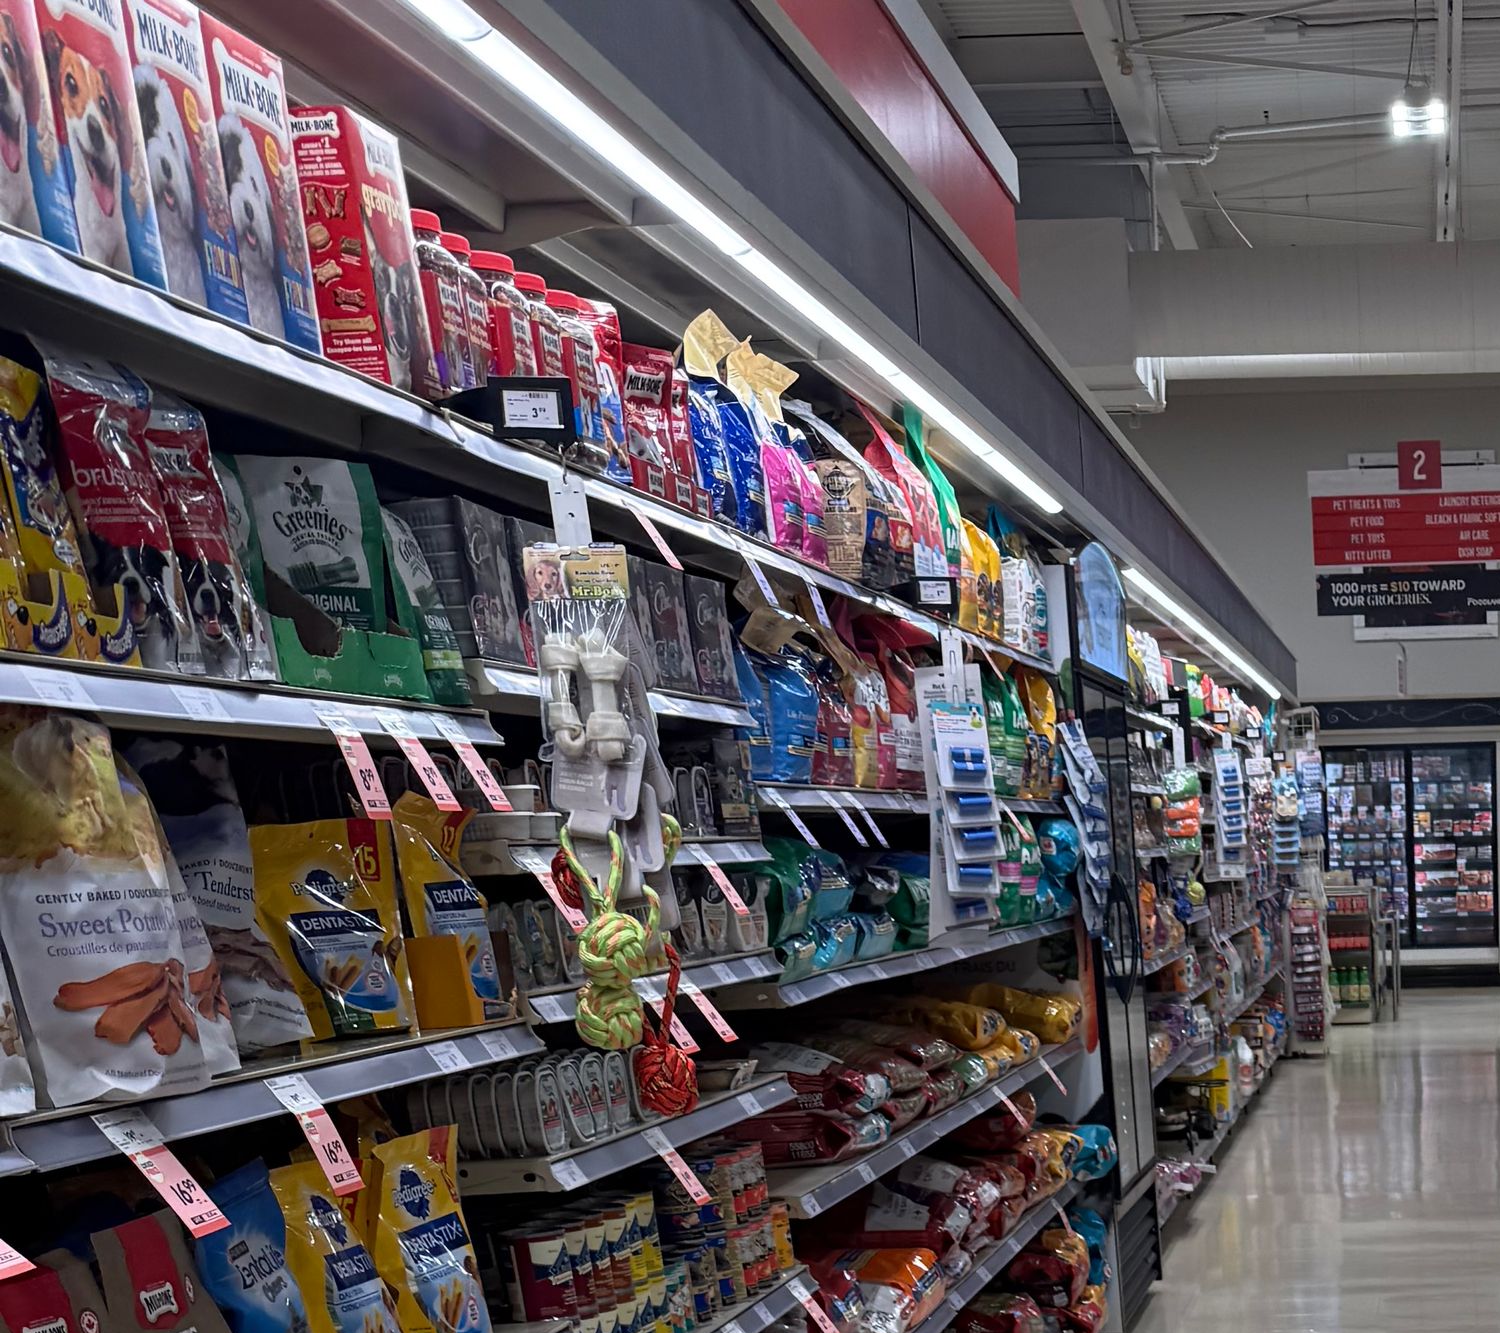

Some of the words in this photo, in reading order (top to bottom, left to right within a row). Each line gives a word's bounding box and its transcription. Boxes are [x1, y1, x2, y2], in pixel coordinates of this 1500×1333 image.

[1413, 450, 1427, 480] 2
[1333, 500, 1346, 511] PET
[1383, 498, 1400, 509] TOYS
[1439, 496, 1469, 507] LAUNDRY
[273, 508, 348, 541] Greenies
[1350, 517, 1364, 527] PET
[1365, 516, 1384, 527] FOOD
[1351, 534, 1364, 544] PET
[1367, 533, 1385, 544] TOYS
[1460, 530, 1471, 541] AIR
[1472, 530, 1489, 541] CARE
[1345, 551, 1366, 562] KITTY
[1458, 547, 1475, 558] DISH
[1475, 547, 1493, 558] SOAP
[1331, 582, 1359, 594] 1000
[1361, 583, 1378, 593] PTS
[1413, 580, 1466, 592] TOWARD
[1332, 595, 1365, 607] YOUR
[35, 892, 83, 905] GENTLY
[86, 889, 121, 902] BAKED
[38, 911, 114, 938] Sweet
[47, 942, 107, 957] Croustilles
